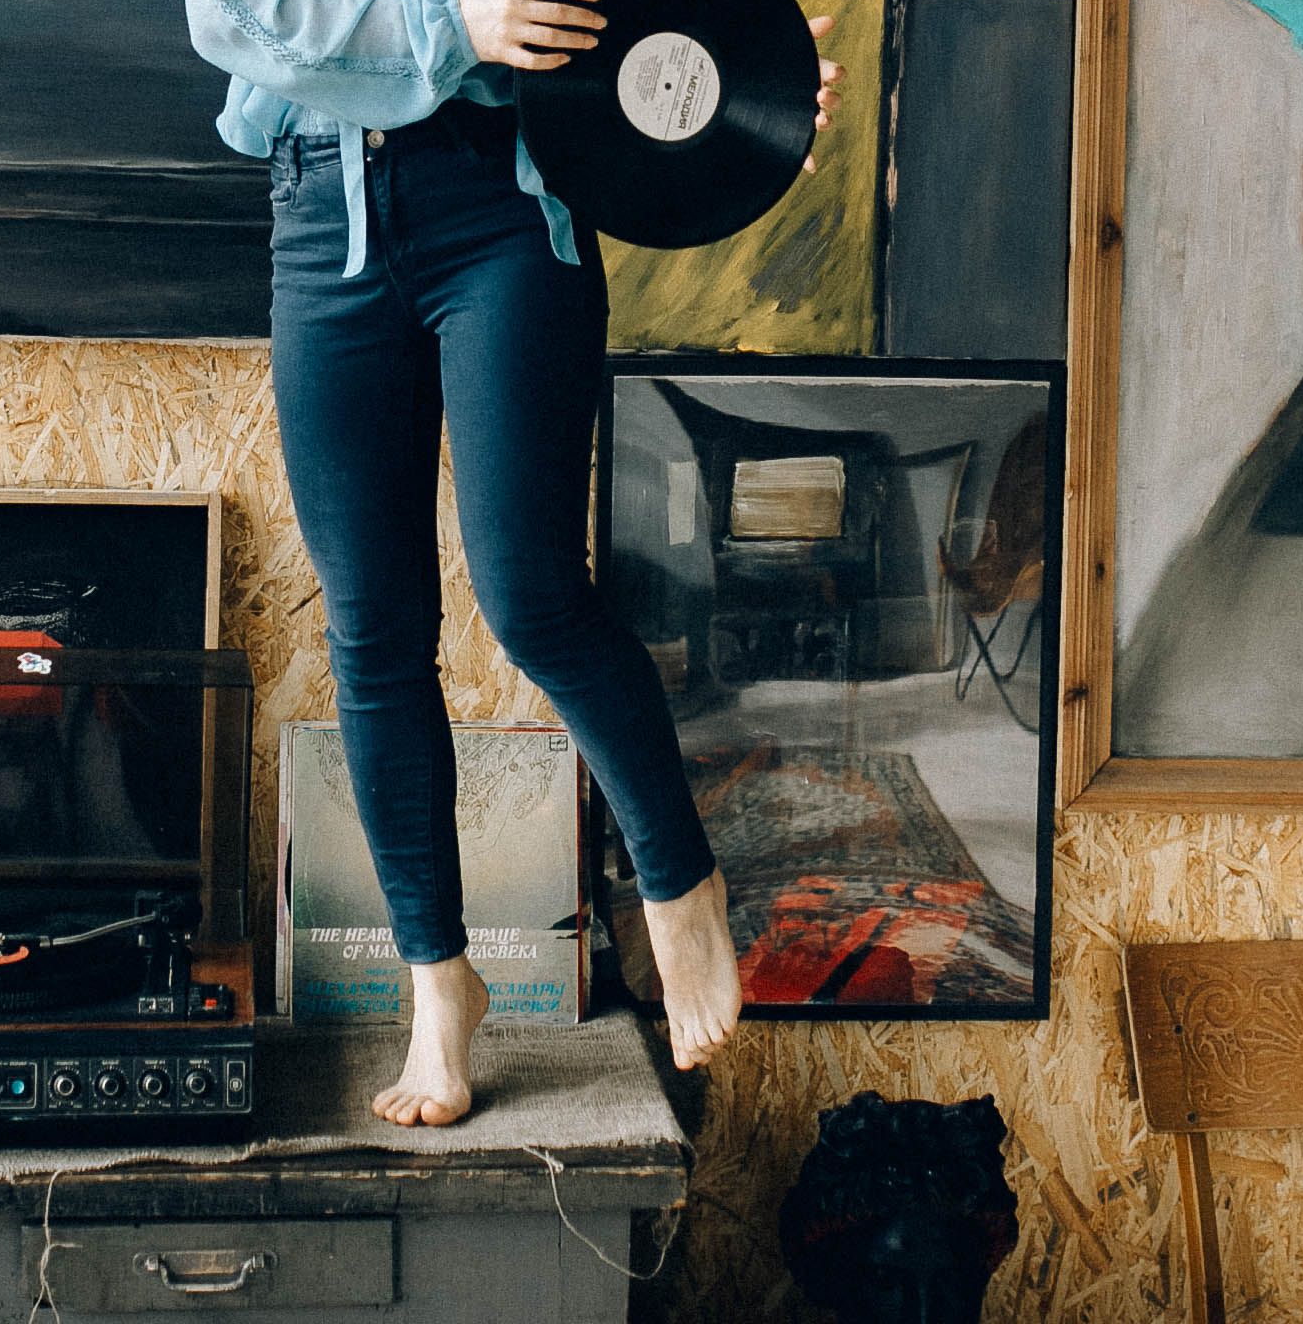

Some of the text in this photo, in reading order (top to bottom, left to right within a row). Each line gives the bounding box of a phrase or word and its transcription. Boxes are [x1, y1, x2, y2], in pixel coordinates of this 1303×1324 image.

[679, 74, 698, 130] МЕЛОДИЯ
[310, 927, 341, 942] THE
[466, 927, 521, 945] ЕРДЦЕ
[342, 944, 364, 960] OF
[464, 944, 537, 959] ЕЛОВЕКА
